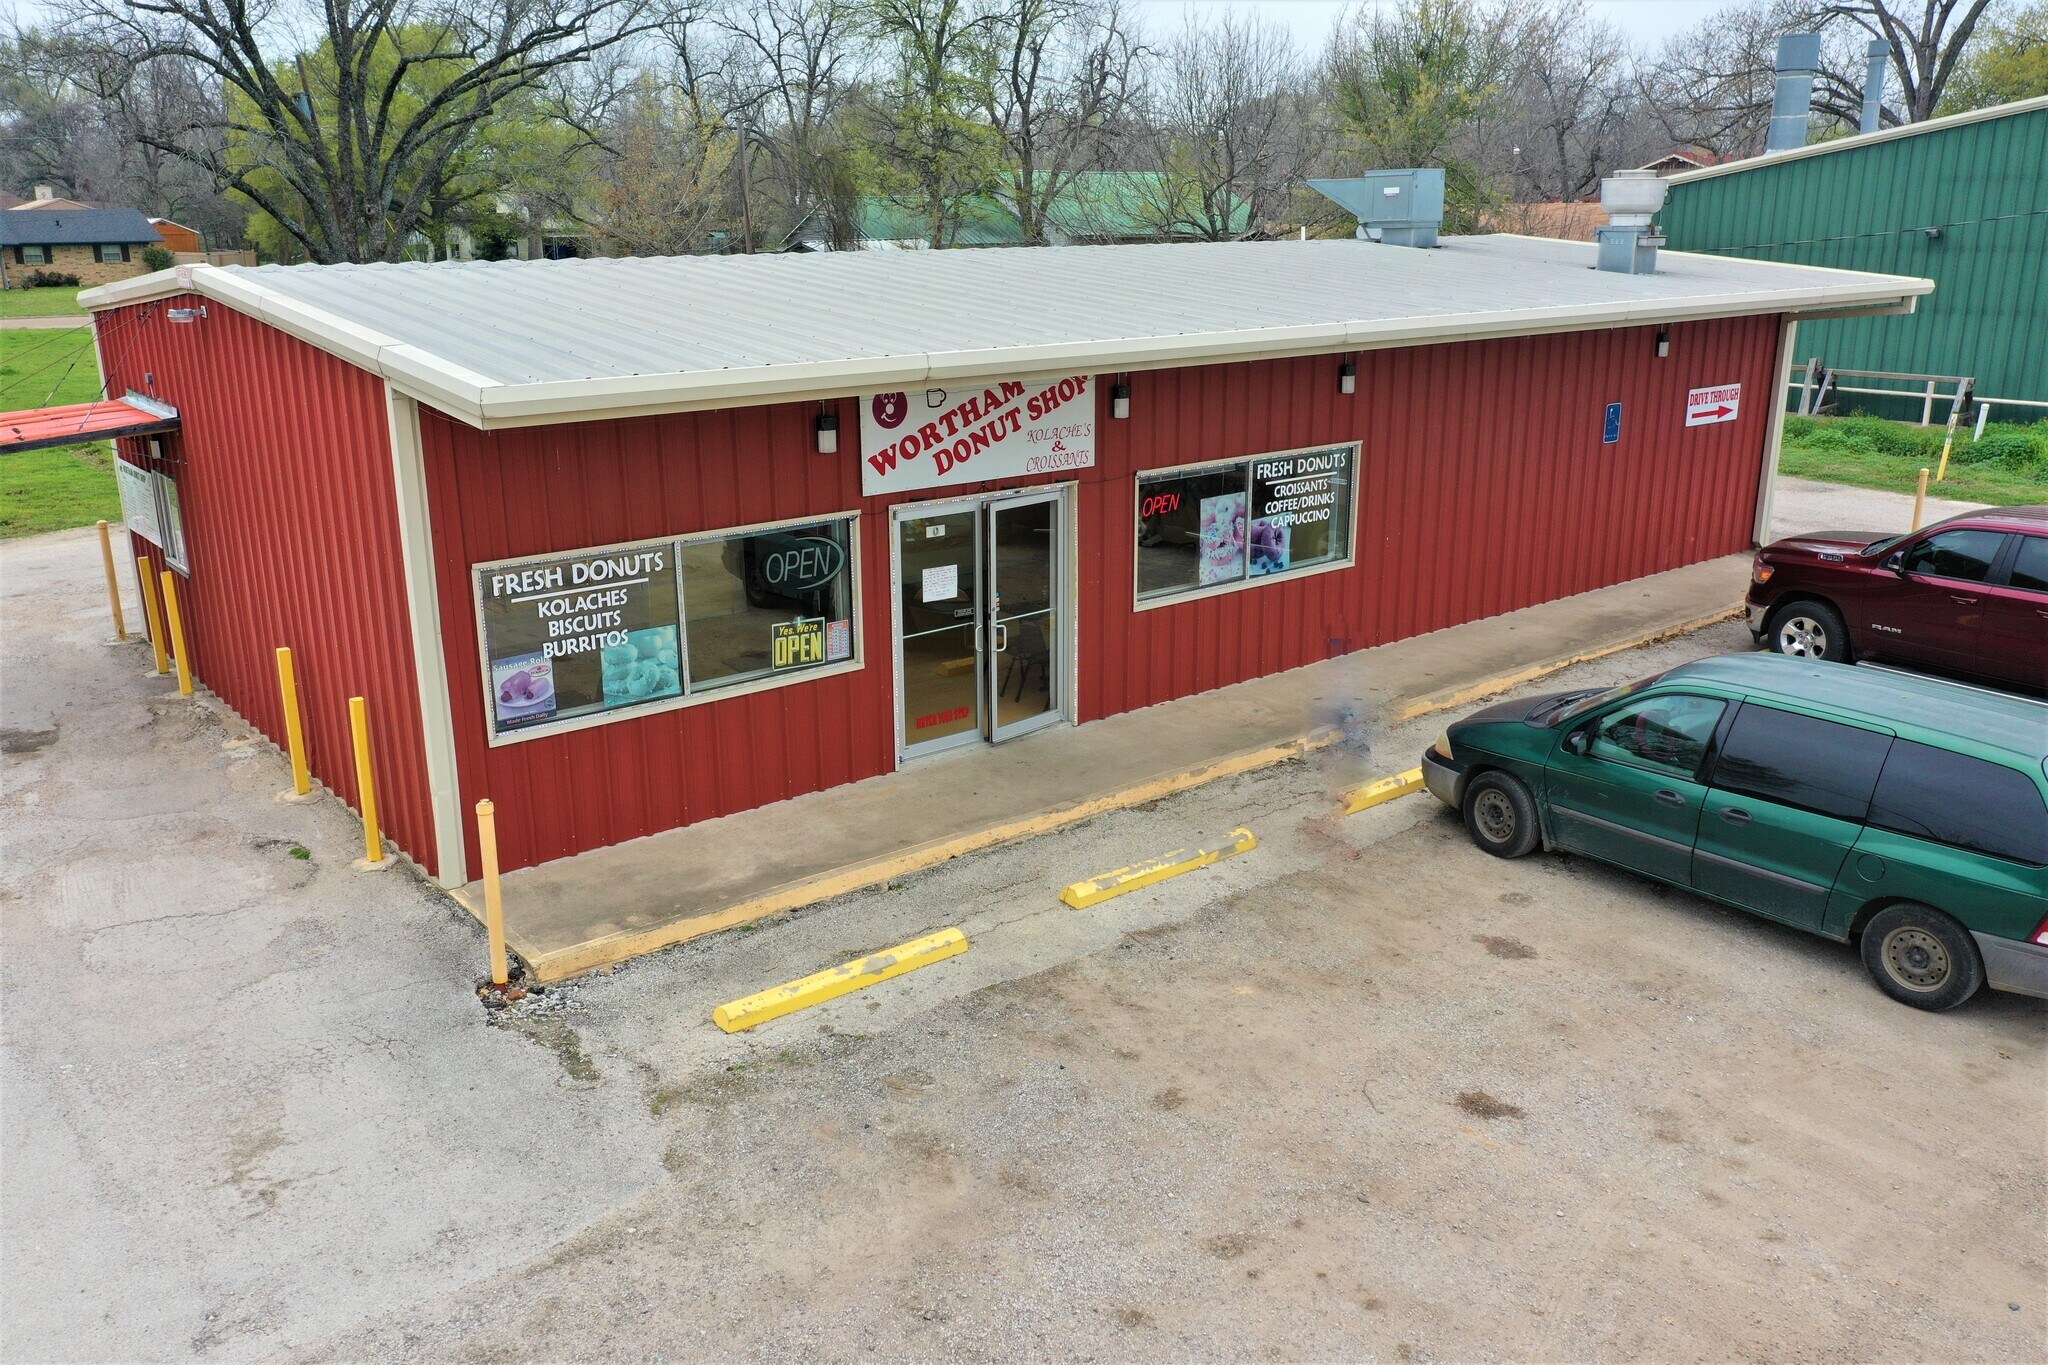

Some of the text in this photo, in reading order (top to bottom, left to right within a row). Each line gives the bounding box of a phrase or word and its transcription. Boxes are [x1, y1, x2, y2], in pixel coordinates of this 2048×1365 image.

[1689, 388, 1740, 406] DRIVE THROUGH
[868, 381, 1025, 476] WORTHAM
[932, 375, 1088, 476] DONUT SHOP
[1027, 423, 1091, 443] KOLACHE'S
[1052, 440, 1066, 452] &
[1026, 450, 1089, 472] CROISSANTS
[1257, 452, 1346, 480] FRESH DONUTS
[1274, 478, 1328, 498] CROISSANTS
[1142, 493, 1180, 517] OPEN
[1265, 492, 1335, 514] COFFEE/DRINKS
[1271, 508, 1330, 529] CAPPUCCINO
[491, 551, 664, 597] FRESH DONUTS
[765, 546, 831, 584] OPEN
[537, 588, 628, 618] KOLACHES
[548, 609, 622, 638] BISCUITS
[1871, 623, 1902, 634] RAM
[542, 629, 628, 659] BURRITOS
[775, 631, 822, 667] OPEN
[492, 660, 528, 672] Sausage
